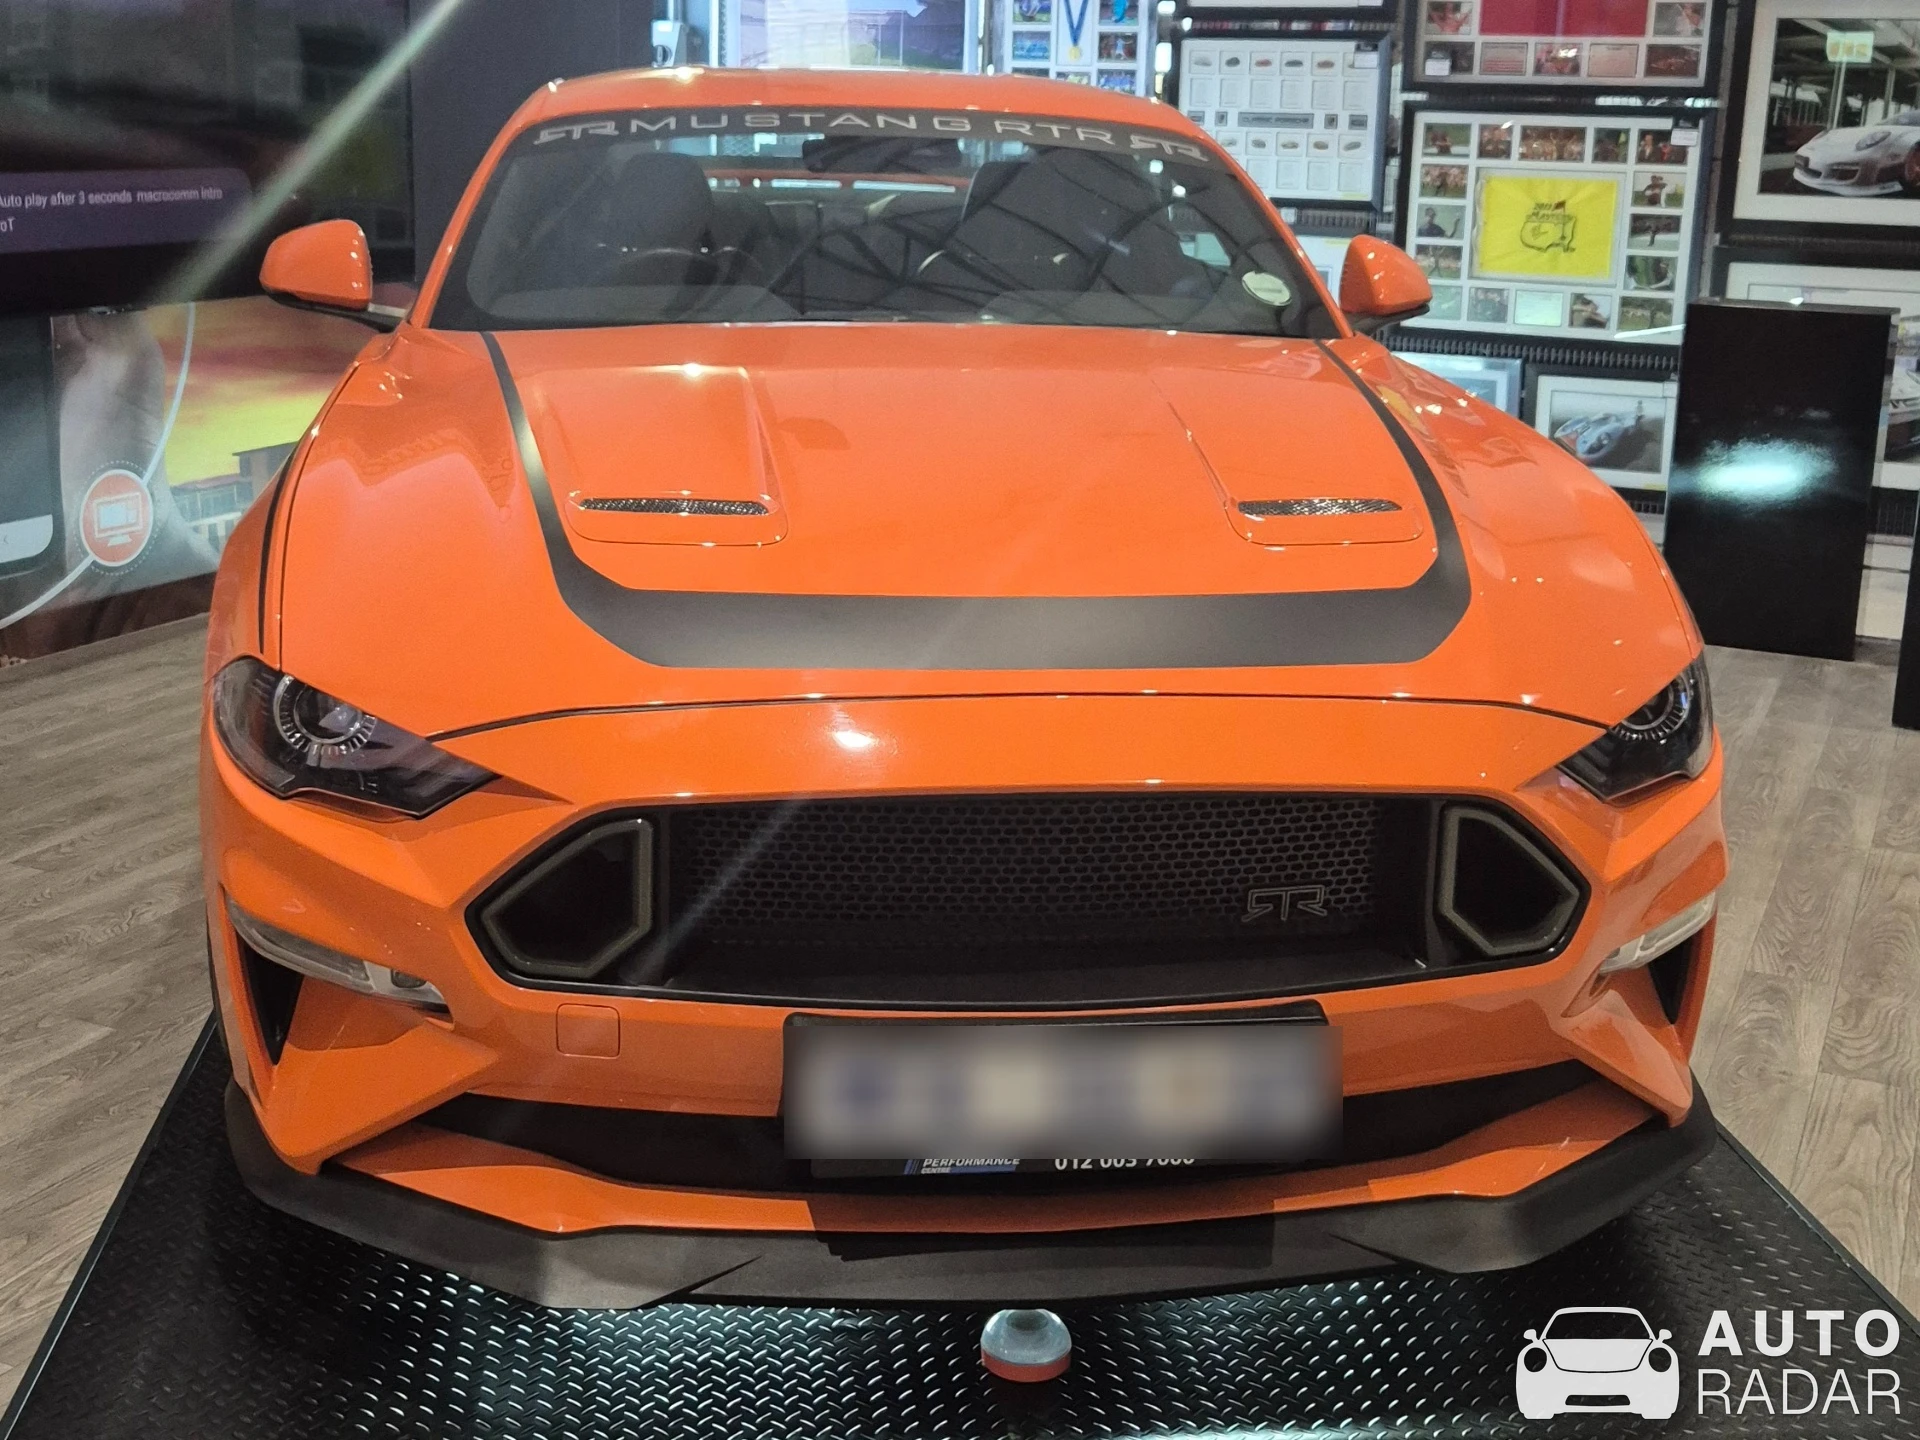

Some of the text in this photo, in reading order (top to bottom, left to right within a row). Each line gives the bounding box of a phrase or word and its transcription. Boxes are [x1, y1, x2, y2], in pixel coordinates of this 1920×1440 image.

[630, 112, 973, 134] MUSTANG
[995, 119, 1116, 145] RTR
[25, 192, 48, 210] play
[50, 191, 76, 206] after
[79, 190, 85, 206] 3
[88, 189, 132, 204] seconds
[201, 186, 223, 200] intro
[920, 1167, 951, 1175] CENTRE
